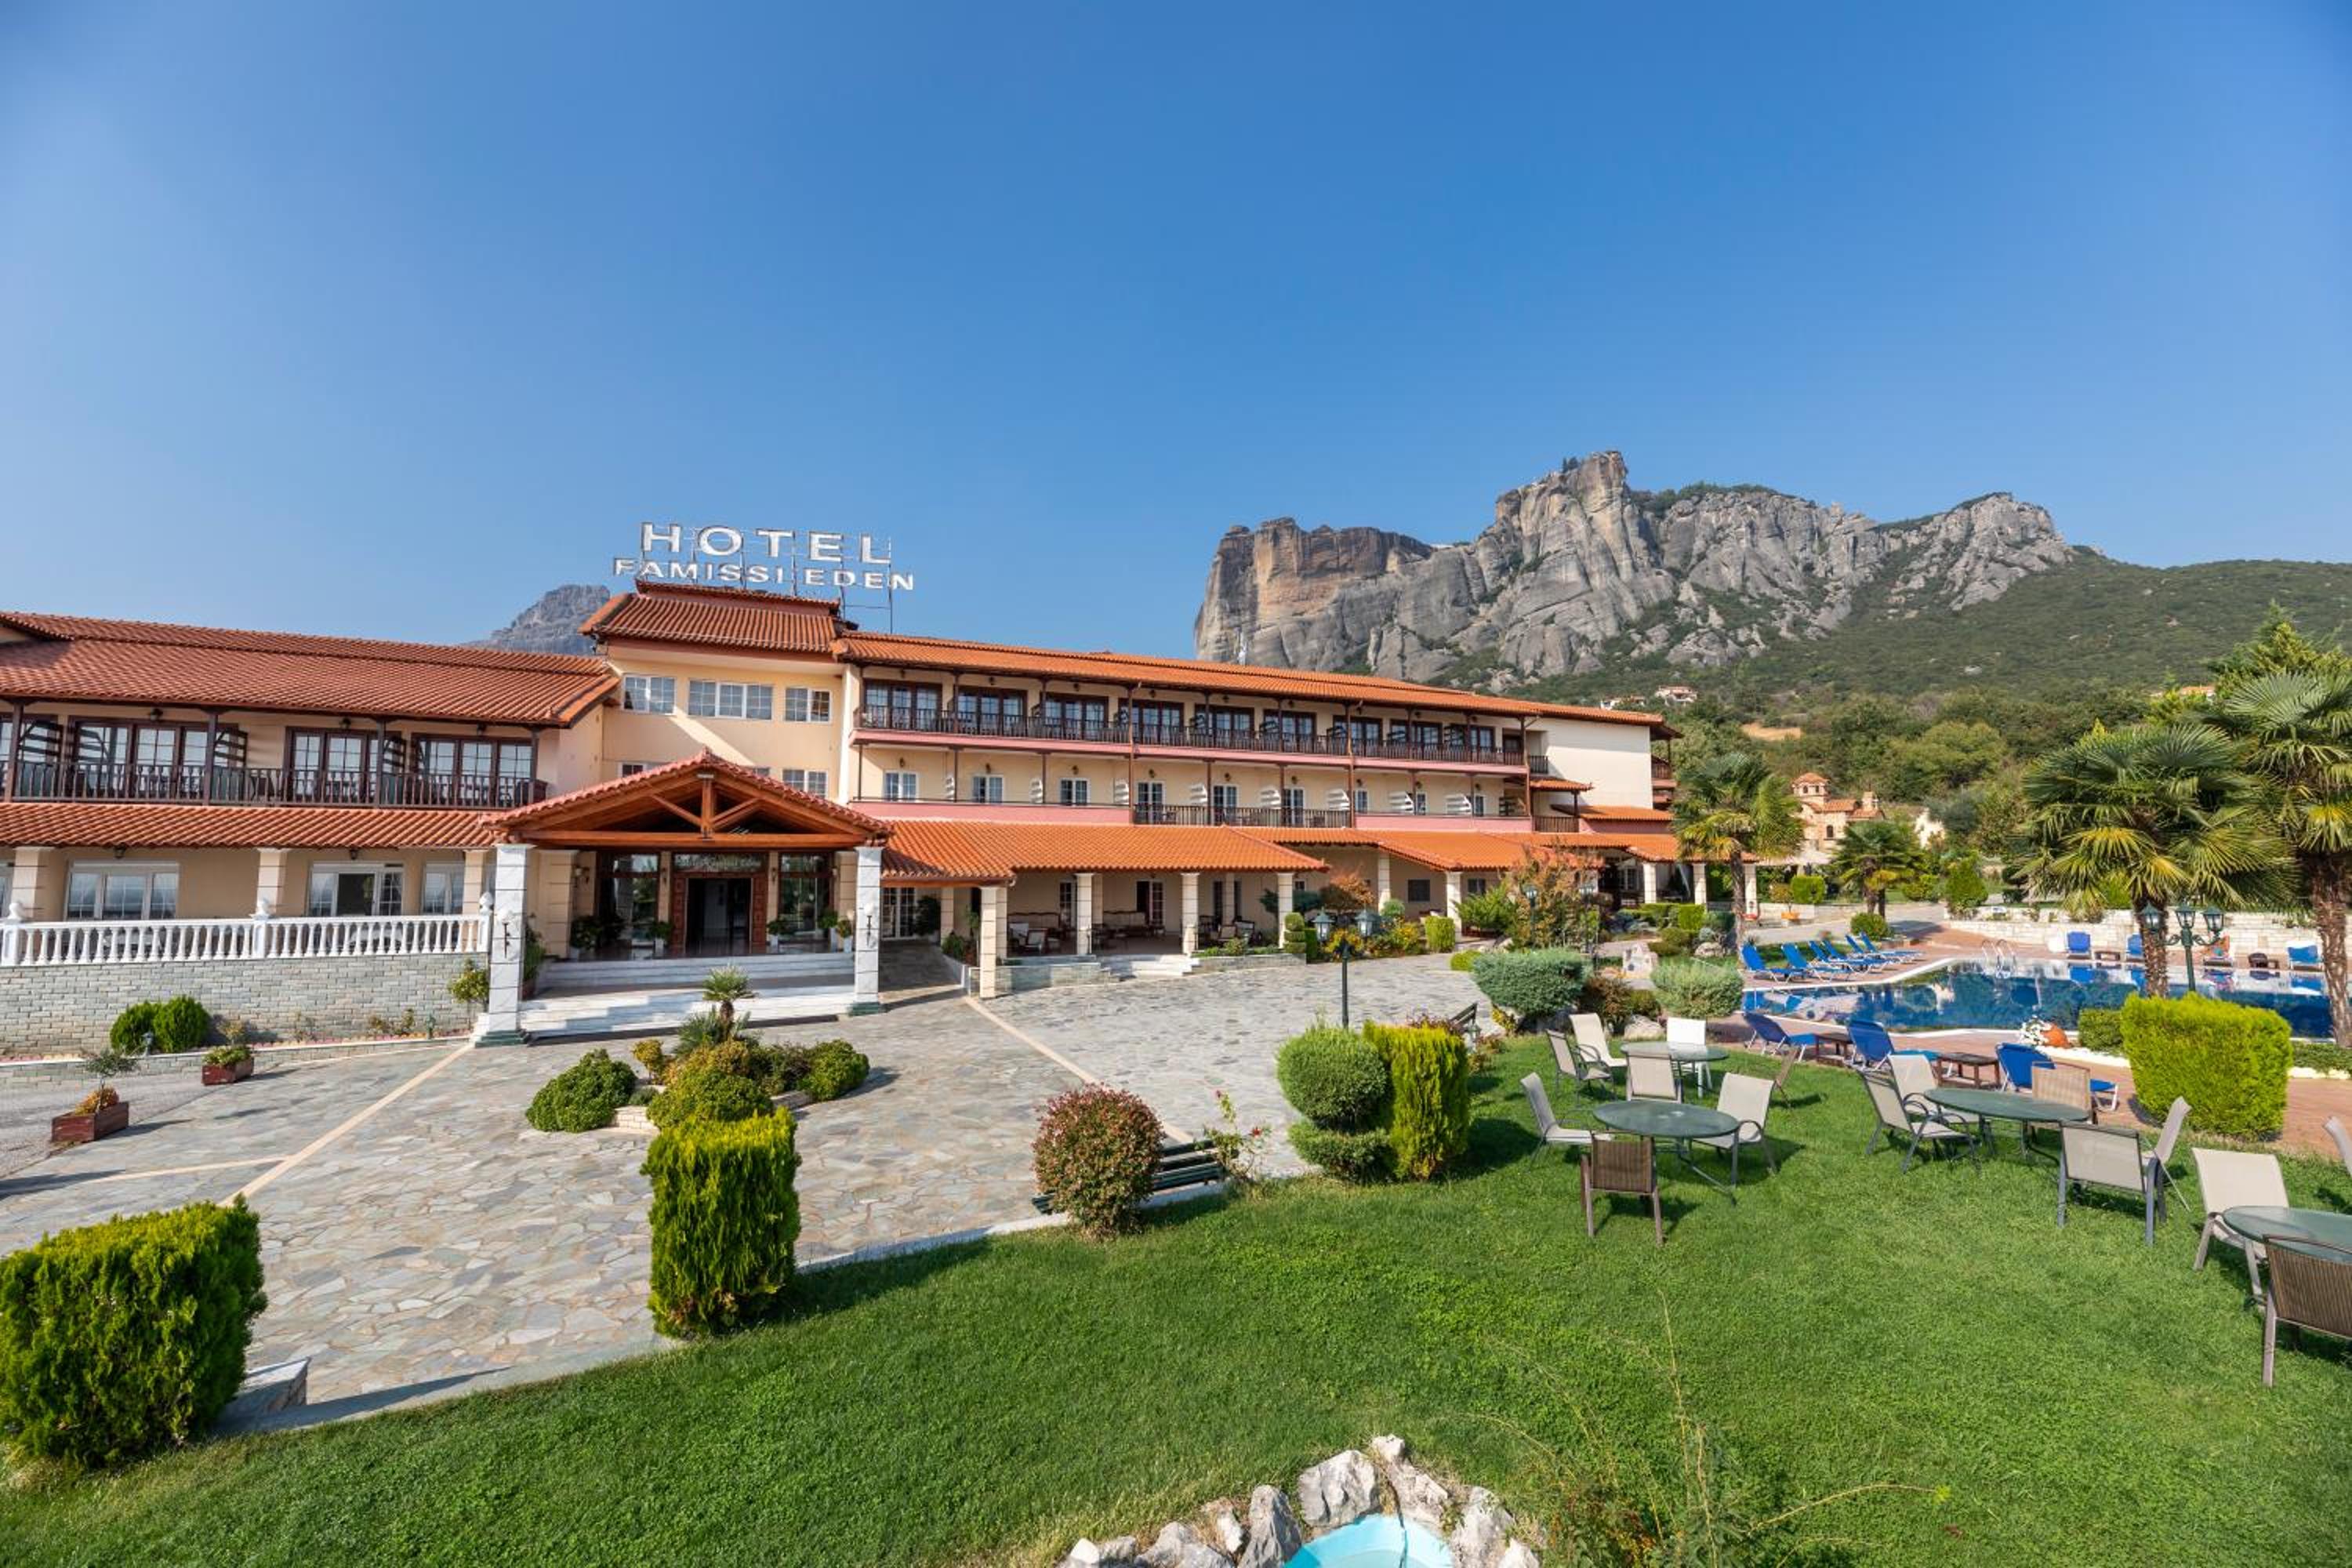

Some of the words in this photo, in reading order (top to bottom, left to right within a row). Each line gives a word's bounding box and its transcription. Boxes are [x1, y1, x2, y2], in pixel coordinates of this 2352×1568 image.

[641, 521, 891, 564] HOTEL
[615, 557, 784, 583] FAMISSI
[804, 567, 913, 590] EDEN
